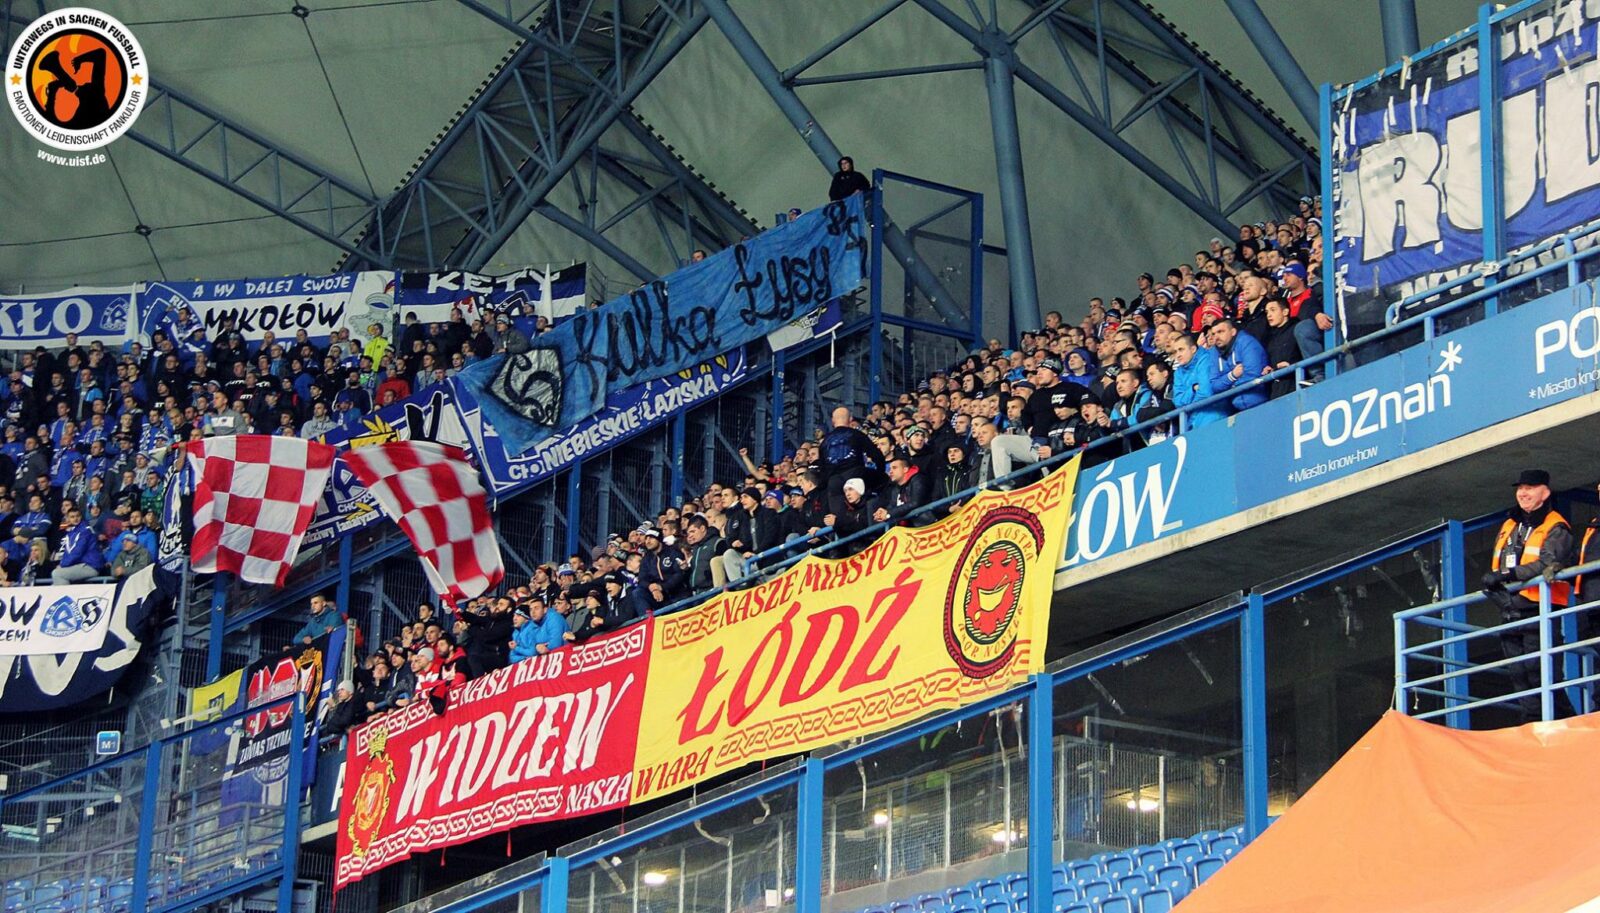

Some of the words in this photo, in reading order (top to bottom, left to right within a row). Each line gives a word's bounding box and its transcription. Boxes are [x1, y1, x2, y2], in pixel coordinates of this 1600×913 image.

[193, 285, 204, 298] A
[214, 283, 235, 297] MY
[245, 280, 293, 295] DALEJ
[303, 276, 351, 292] SWOJE
[205, 297, 345, 335] MIKOŁÓW
[541, 406, 641, 471] NIEBIESKIE
[643, 374, 719, 420] ŁAZISKA
[1328, 446, 1378, 471] know-how
[719, 569, 799, 629] NASZE
[798, 536, 899, 597] MIASTO
[459, 665, 511, 705] NASZ
[513, 651, 565, 687] KLUB
[676, 567, 924, 745] ŁÓDŹ
[395, 673, 634, 824] WIDZEW
[565, 770, 633, 814] NASZA
[635, 745, 713, 798] WIARA
